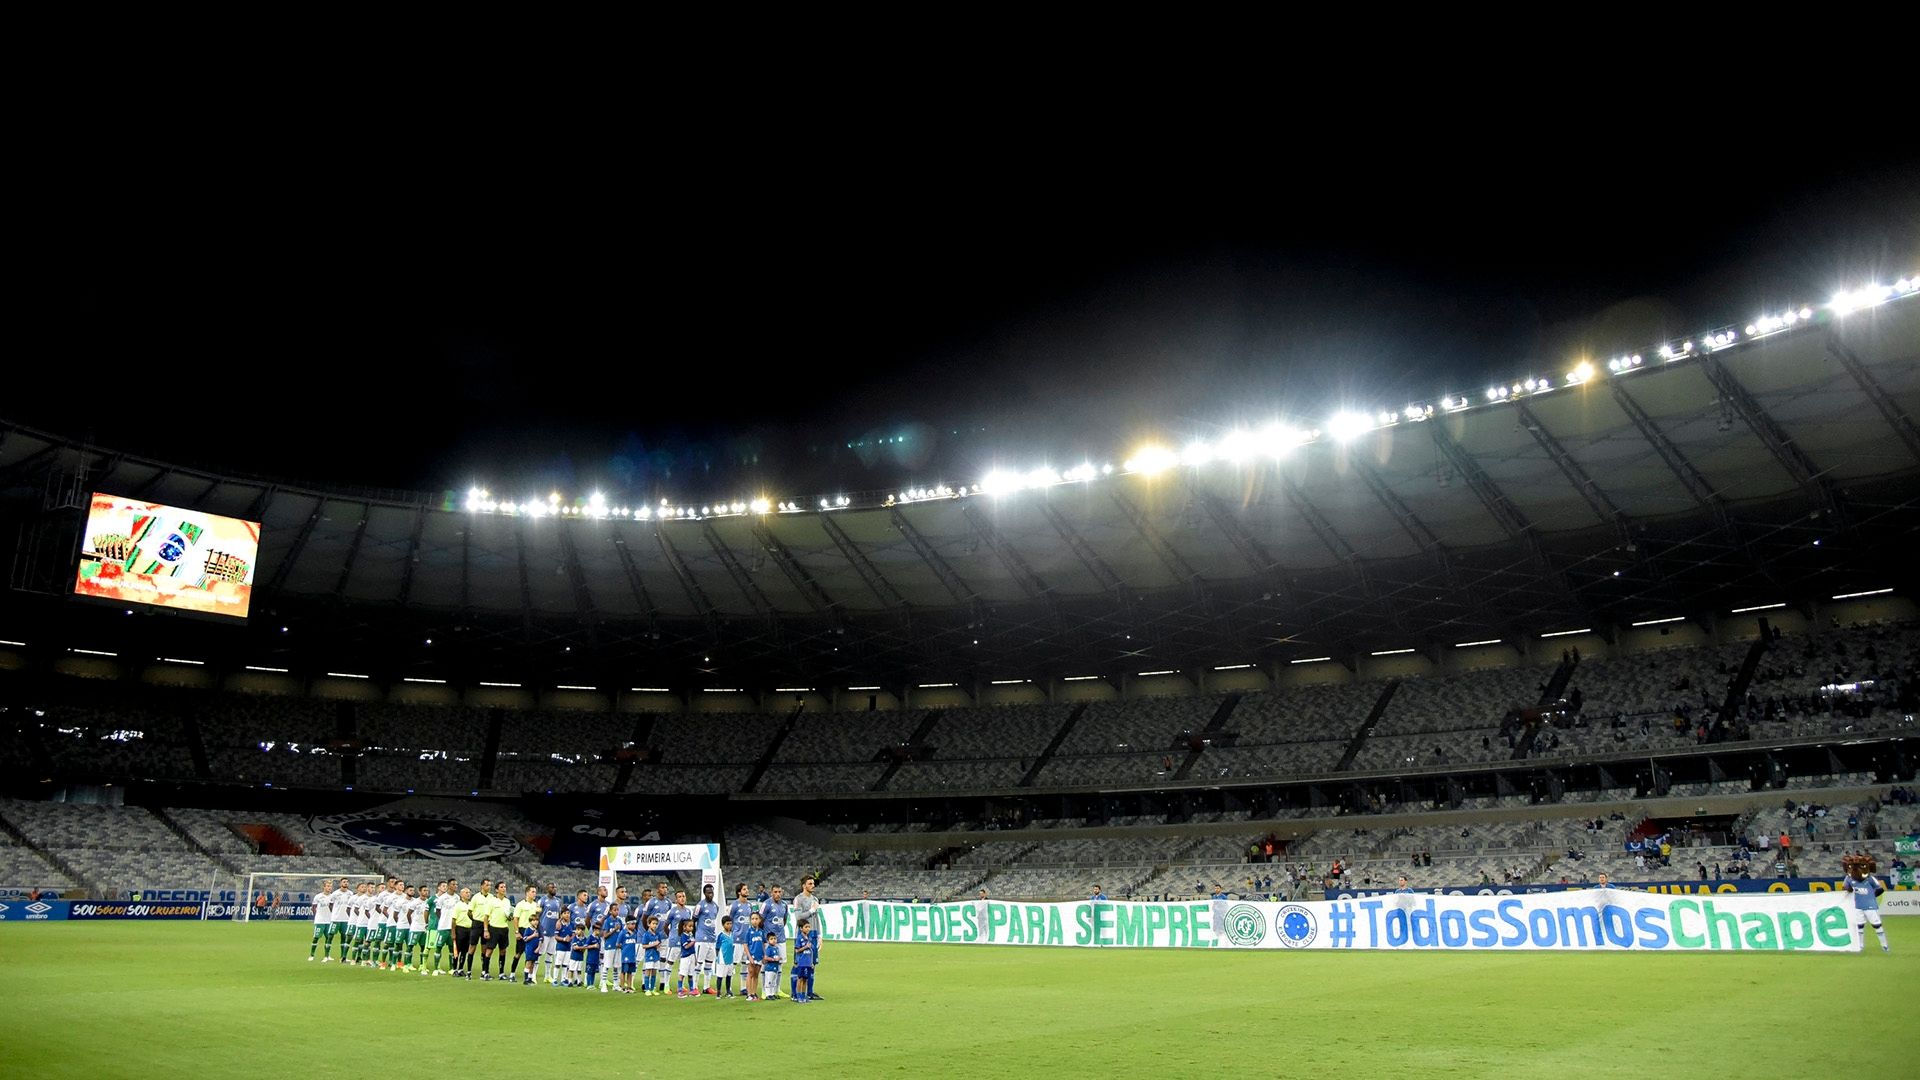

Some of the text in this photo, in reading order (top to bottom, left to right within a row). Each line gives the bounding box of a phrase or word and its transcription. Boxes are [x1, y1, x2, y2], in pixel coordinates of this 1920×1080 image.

[636, 852, 692, 863] PRIMEIRA LIGA
[225, 905, 240, 916] APP
[987, 904, 1064, 945] PARA
[1076, 904, 1219, 947] SEMPRE.
